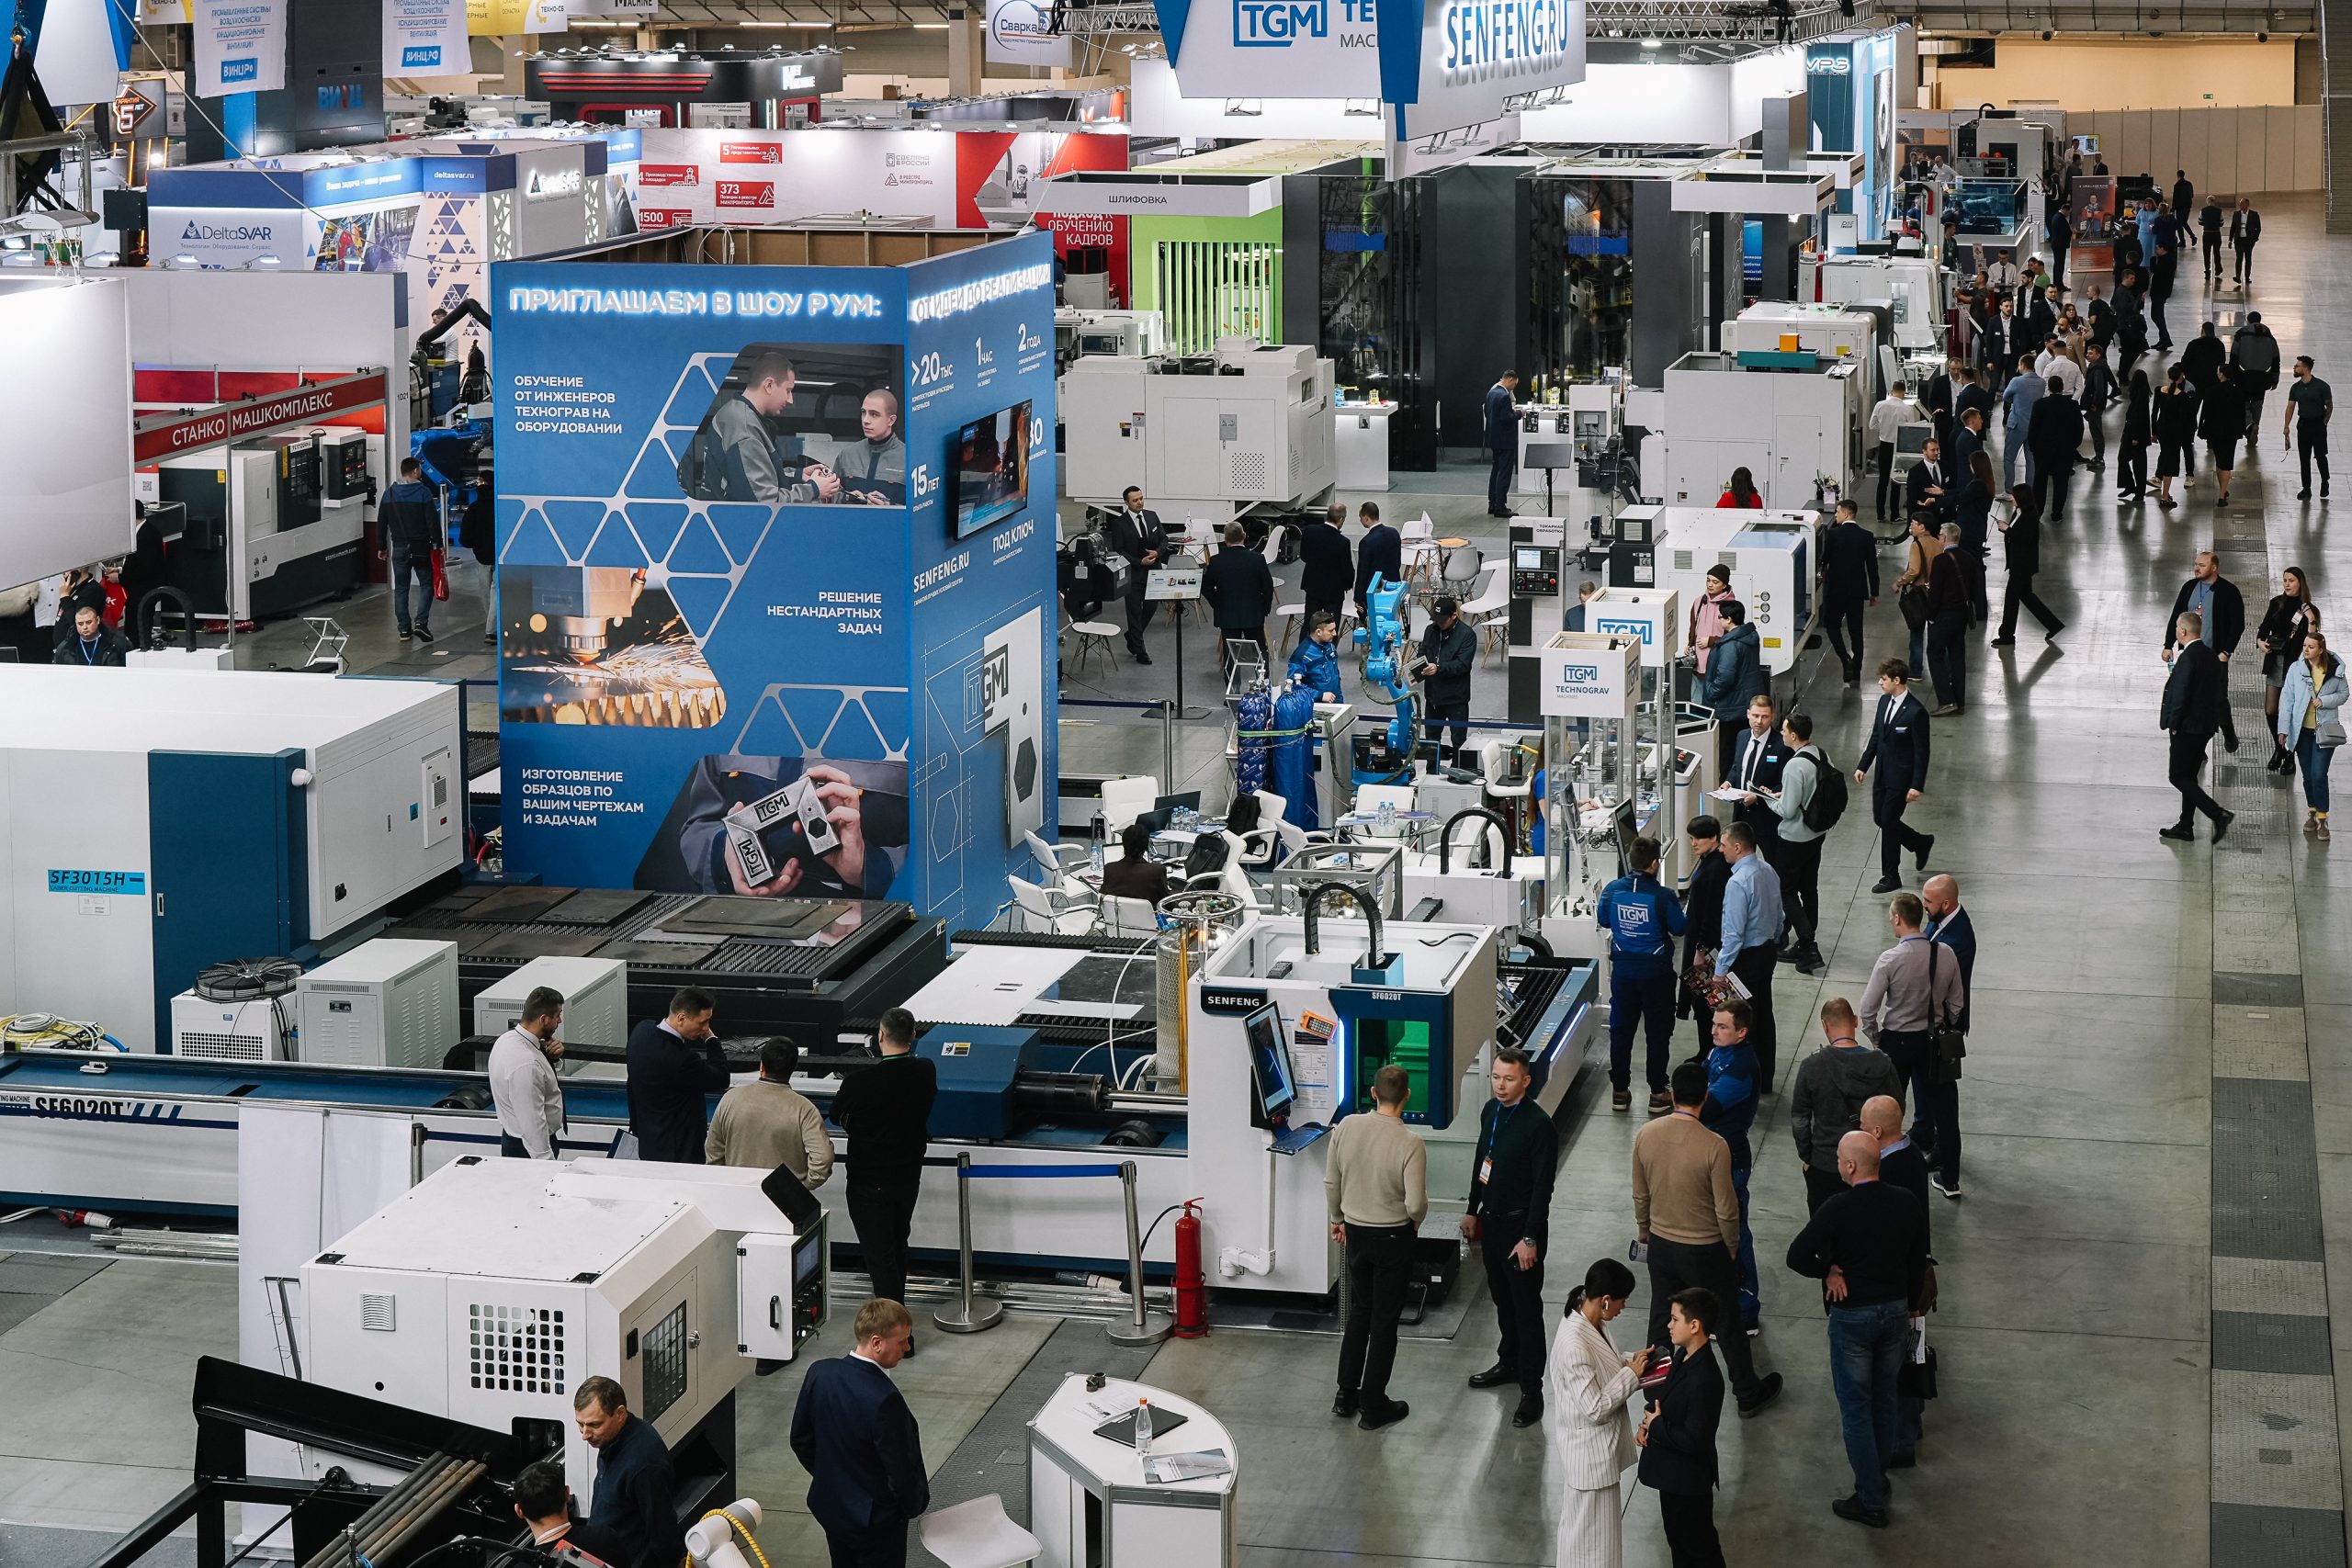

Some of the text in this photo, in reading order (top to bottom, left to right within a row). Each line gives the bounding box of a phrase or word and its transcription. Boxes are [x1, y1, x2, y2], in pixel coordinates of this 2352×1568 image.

[1001, 19, 1037, 34] Сварка
[1241, 6, 1317, 38] TGM
[1446, 0, 1568, 69] SENFENG.RU
[406, 50, 439, 62] ВИНЦ.РФ
[120, 104, 134, 130] 5
[722, 145, 729, 156] 5
[720, 184, 740, 194] 373
[1108, 195, 1168, 204] ШЛИФОВКА
[639, 212, 663, 222] 1500
[1047, 220, 1114, 232] ОБУЧЕНИЮ
[202, 225, 272, 241] DeltaSVAR
[1066, 233, 1114, 245] КАДРОВ
[916, 264, 1051, 321] ОТ ИДЕИ ДО РЕАЛИЗАЦИИ
[509, 288, 706, 314] ПРИГЛАШАЕМ
[712, 292, 730, 314] В
[737, 292, 802, 316] ШОУ
[1018, 322, 1041, 352] 2 ГОДА
[975, 337, 993, 366] 1 ЧАС
[941, 364, 954, 378] ТЫС
[514, 376, 583, 387] ОБУЧЕНИЕ
[514, 390, 616, 403] ОТ ИНЖЕНЕРОВ
[172, 391, 334, 446] СТАНКО МАШКОМПЛЕКС
[514, 406, 610, 418] ТЕХНОГРАВ НА
[514, 422, 622, 434] ОБОРУДОВАНИИ
[910, 463, 940, 499] 15 ЛЕТ
[993, 534, 1011, 554] ПОД
[1012, 519, 1034, 545] КЛЮЧ
[913, 551, 969, 592] SENFENG.RU
[819, 592, 882, 604] РЕШЕНИЕ
[767, 605, 882, 618] НЕСТАНДАРТНЫХ
[837, 623, 882, 635] ЗАДАЧ
[1567, 668, 1595, 681] TGM
[1555, 685, 1610, 694] TECHNOGRAV
[522, 769, 623, 782] ИЗГОТОВЛЕНИЕ
[522, 784, 613, 796] ОБРАЗЦОВ ПО
[523, 799, 644, 813] ВАШИМ ЧЕРТЕЖАМ
[758, 797, 787, 818] TGM
[523, 814, 597, 826] И ЗАДАЧАМ
[50, 870, 126, 886] SF3015H
[1620, 908, 1645, 921] TGM
[1207, 996, 1261, 1007] SENFENG
[1372, 991, 1402, 1001] SF6020T
